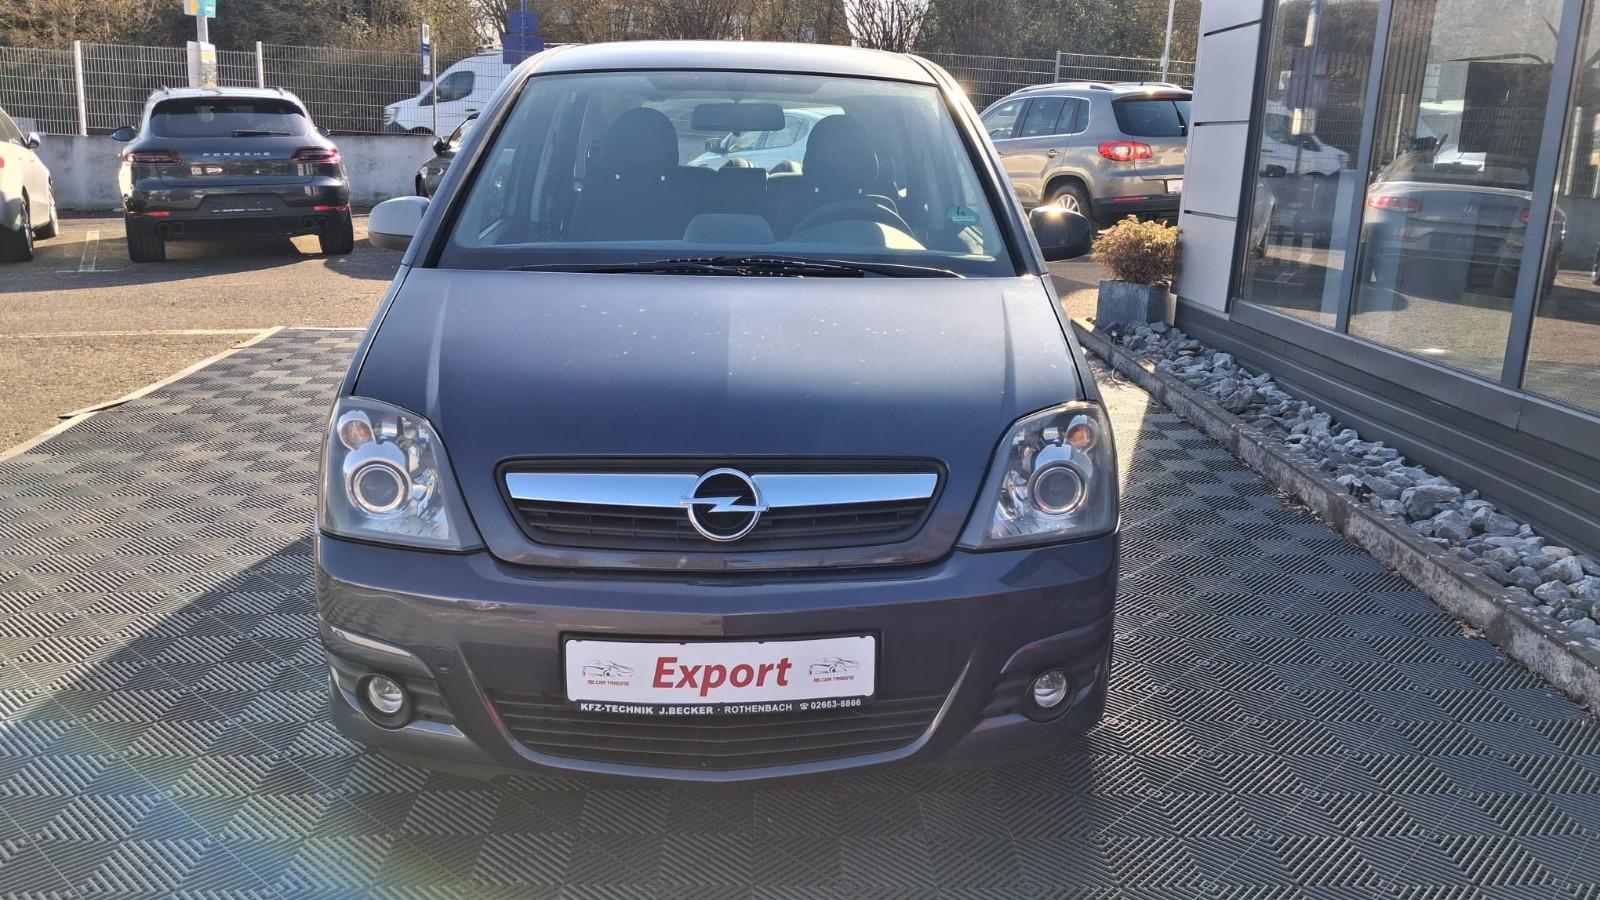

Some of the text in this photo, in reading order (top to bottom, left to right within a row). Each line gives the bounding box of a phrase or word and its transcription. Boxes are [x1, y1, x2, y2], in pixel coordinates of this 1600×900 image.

[652, 656, 792, 697] Export
[580, 699, 862, 715] KFZ-TECHNIK J.BECKER ROTHENBACH 02663-6866
